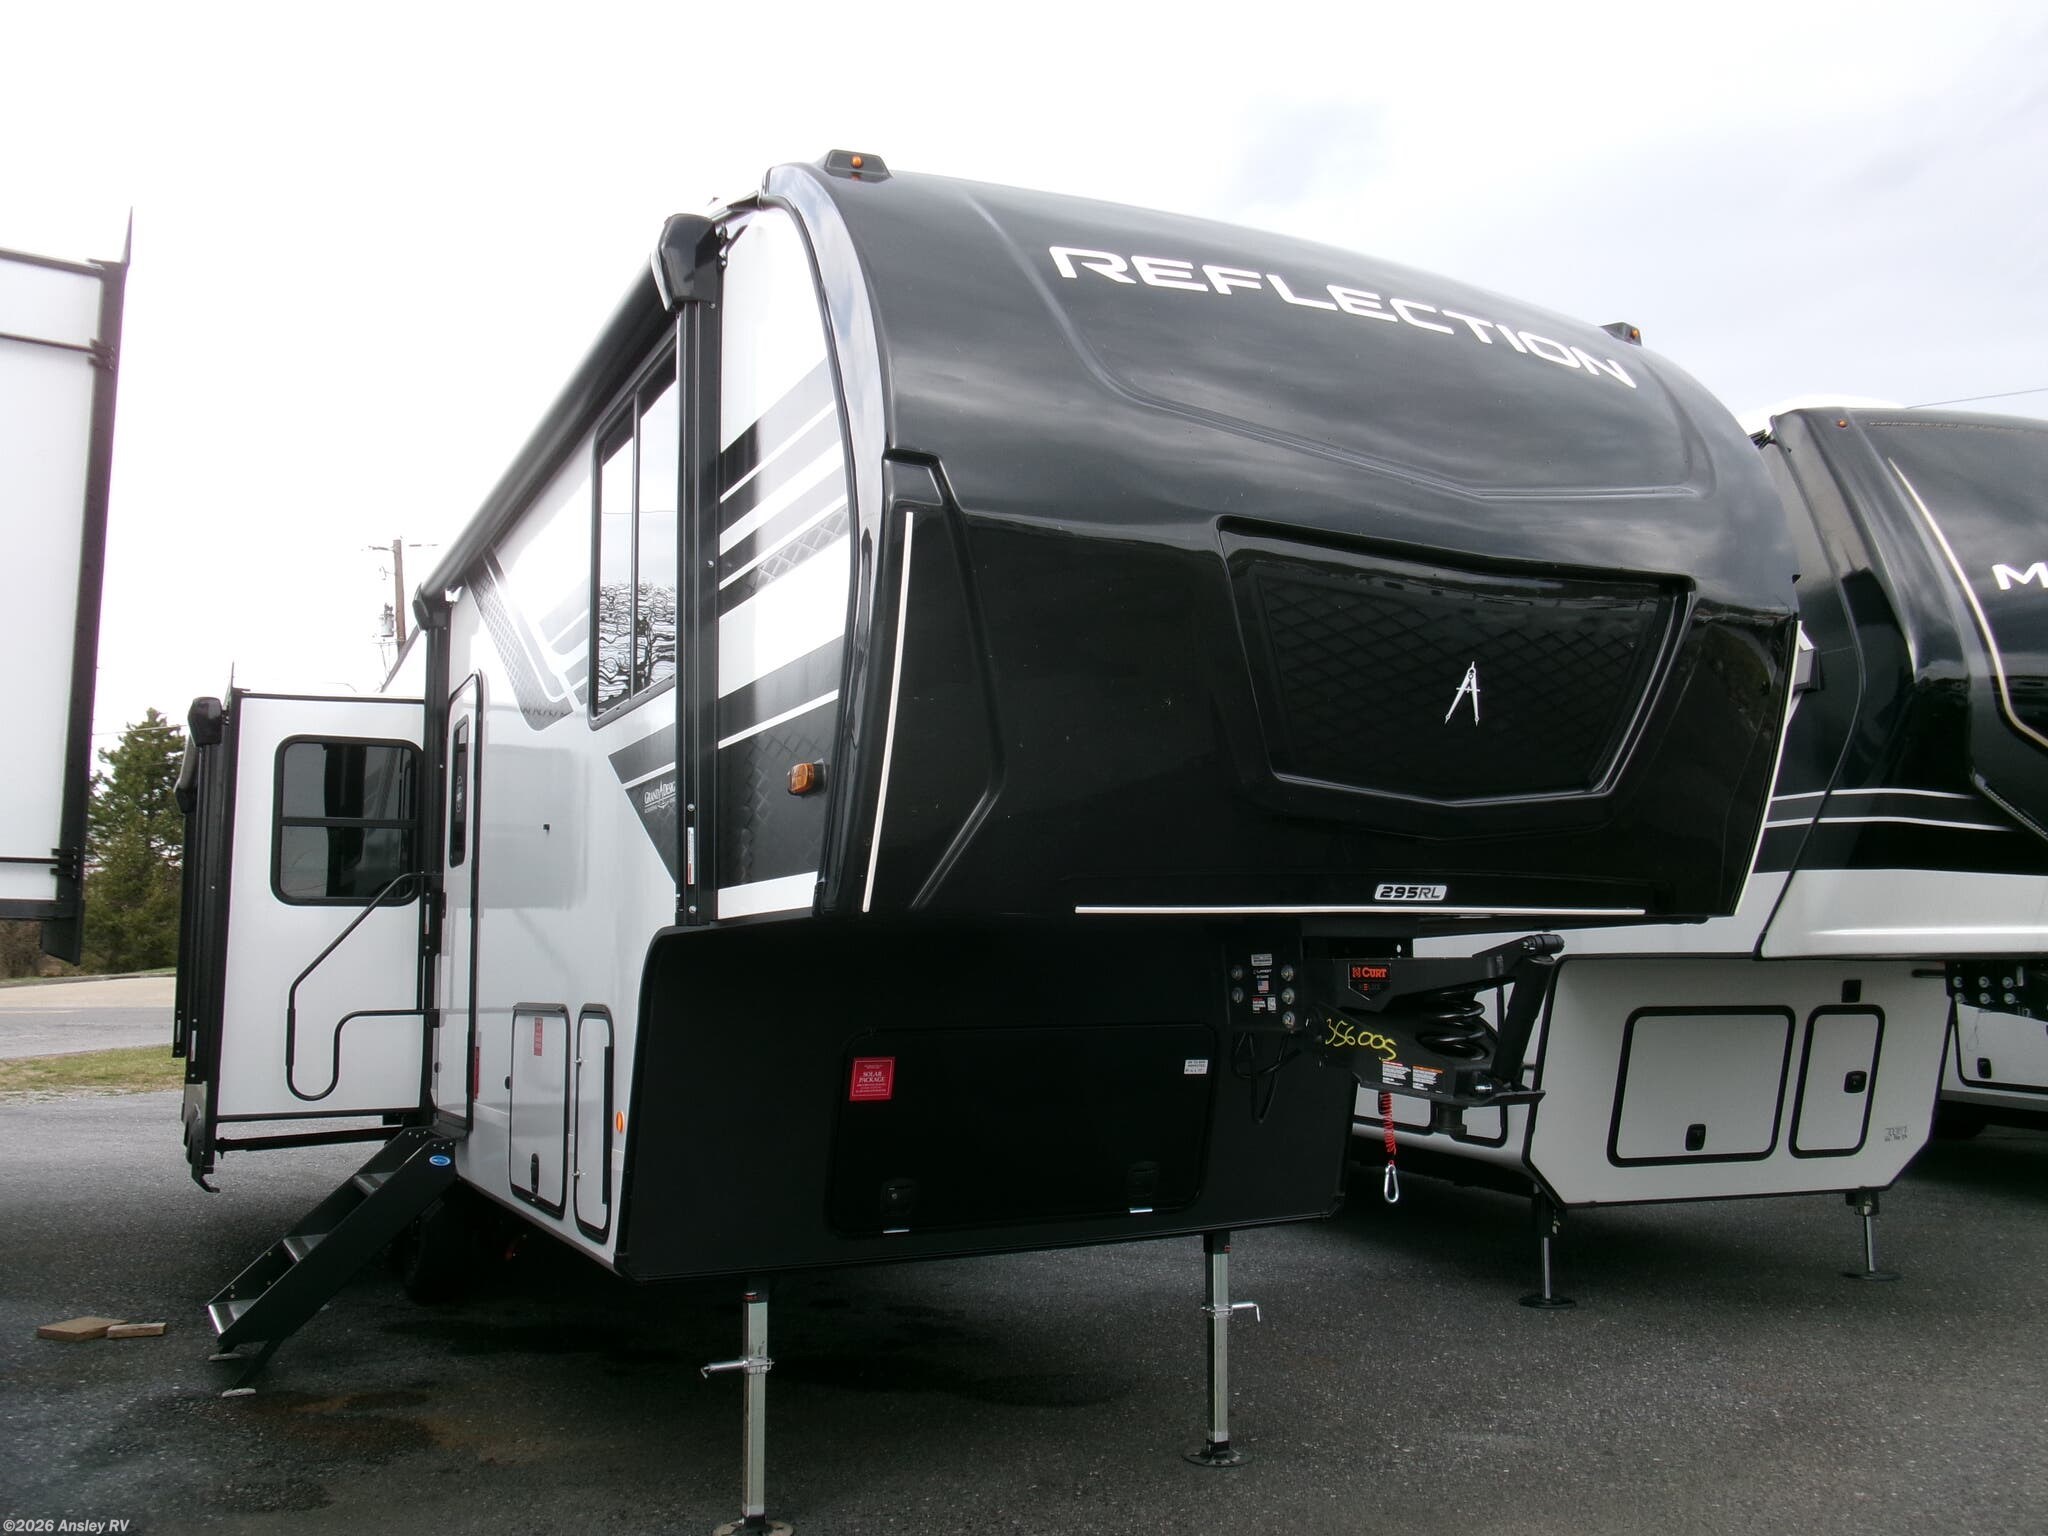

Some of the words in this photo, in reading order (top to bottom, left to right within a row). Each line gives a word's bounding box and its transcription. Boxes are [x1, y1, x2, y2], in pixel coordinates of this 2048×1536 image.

[1049, 246, 1636, 388] REFLECTION
[1380, 886, 1441, 899] 295RL
[1361, 967, 1387, 978] CURT
